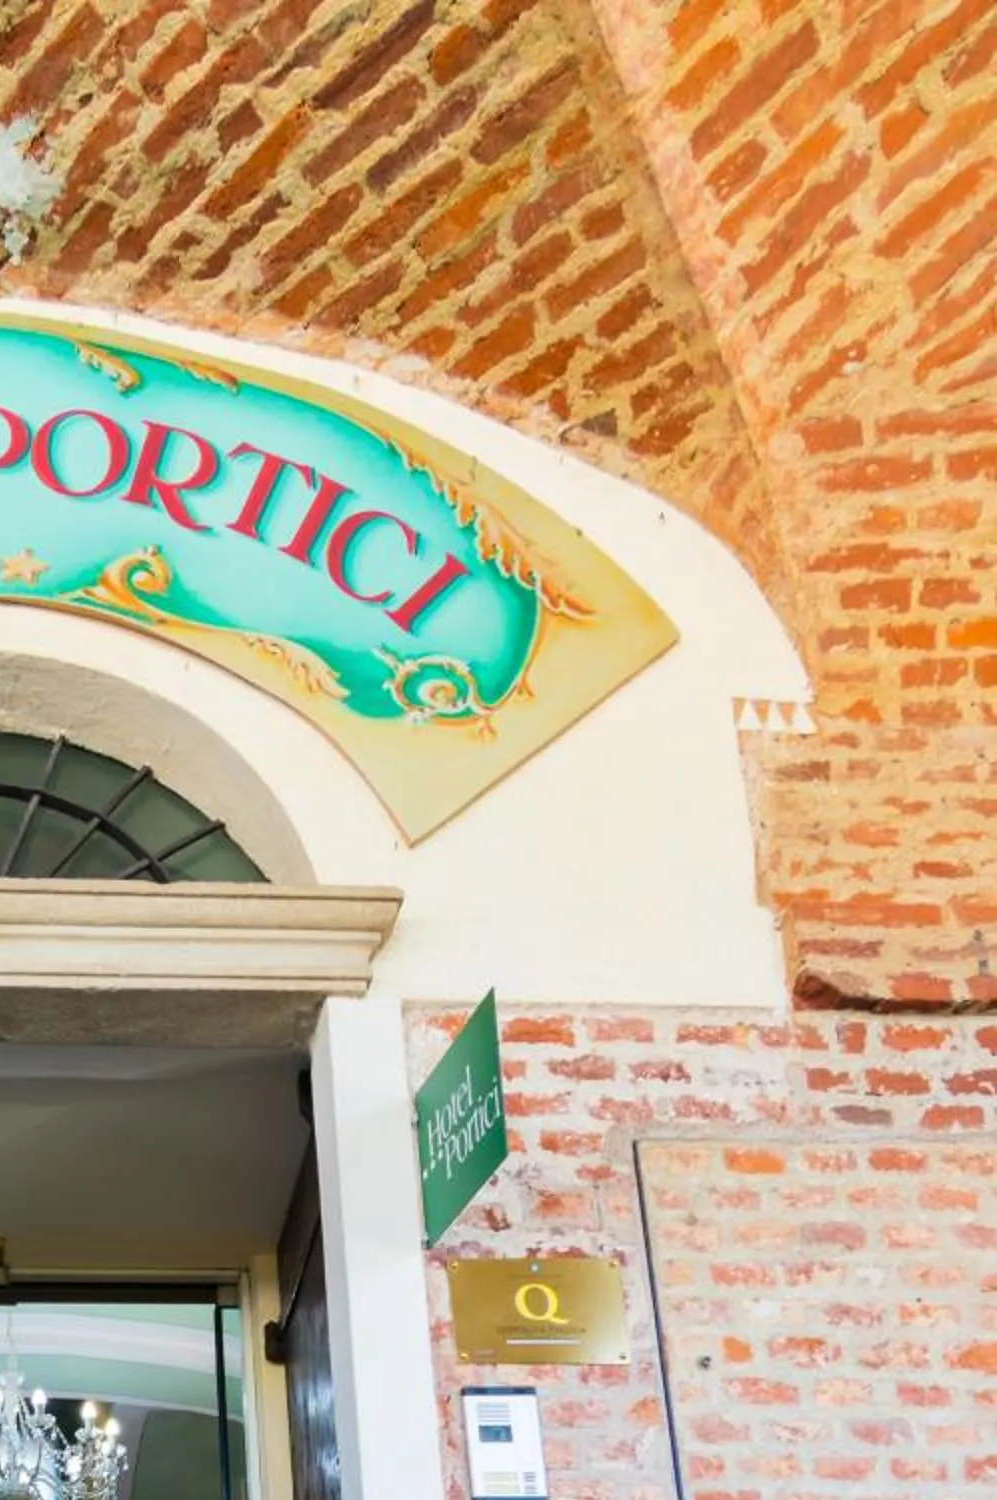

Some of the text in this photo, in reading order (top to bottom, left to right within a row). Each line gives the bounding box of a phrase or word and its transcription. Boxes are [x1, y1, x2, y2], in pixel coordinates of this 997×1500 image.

[427, 1064, 472, 1157] Hotel
[443, 1076, 500, 1179] Portici
[515, 1283, 570, 1325] Q
